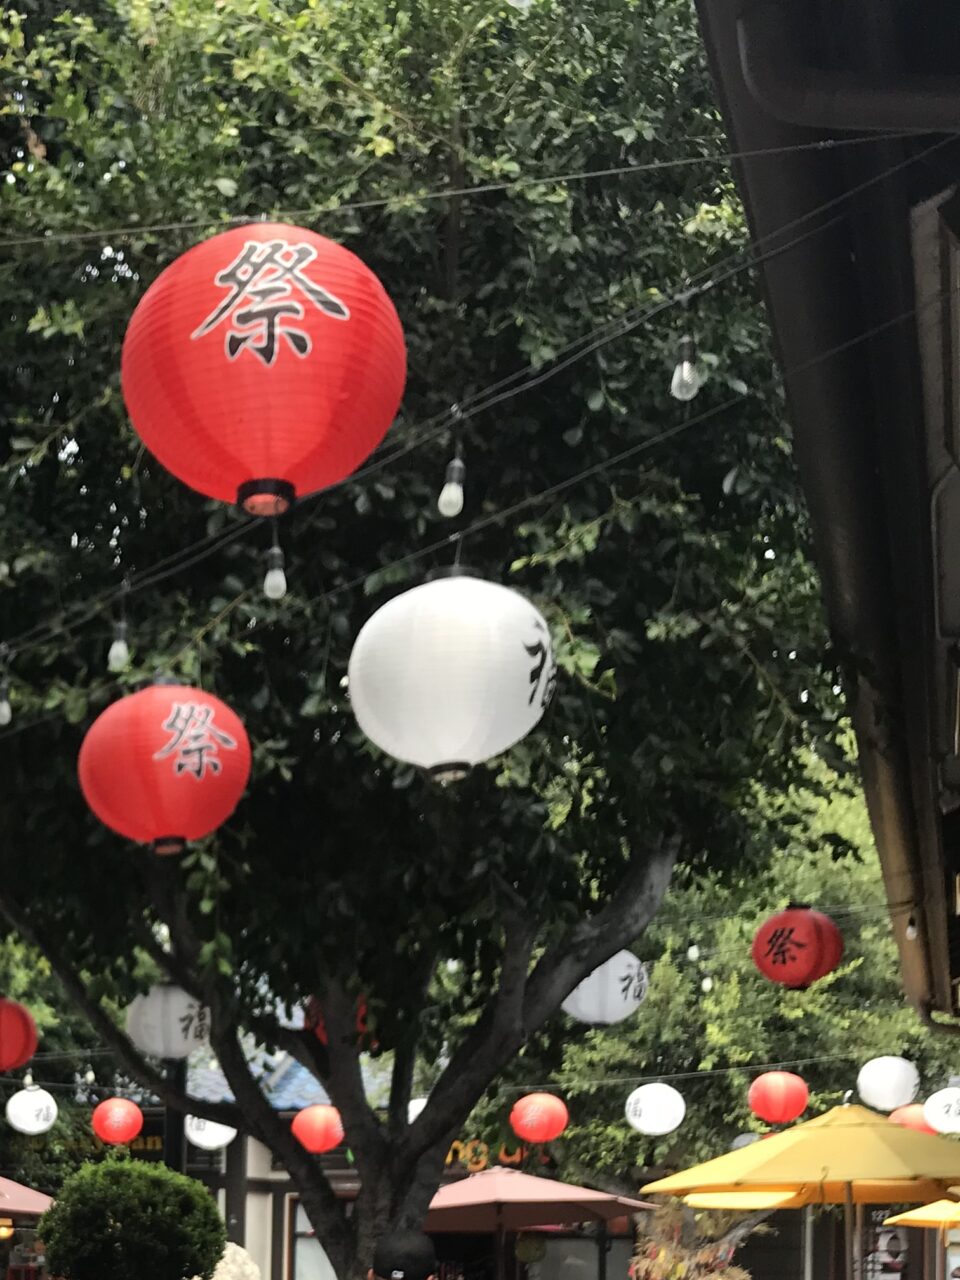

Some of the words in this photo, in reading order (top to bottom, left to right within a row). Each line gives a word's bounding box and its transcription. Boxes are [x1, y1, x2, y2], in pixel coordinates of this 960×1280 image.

[190, 240, 351, 366] 祭
[153, 702, 238, 780] 祭
[764, 927, 808, 966] 祭
